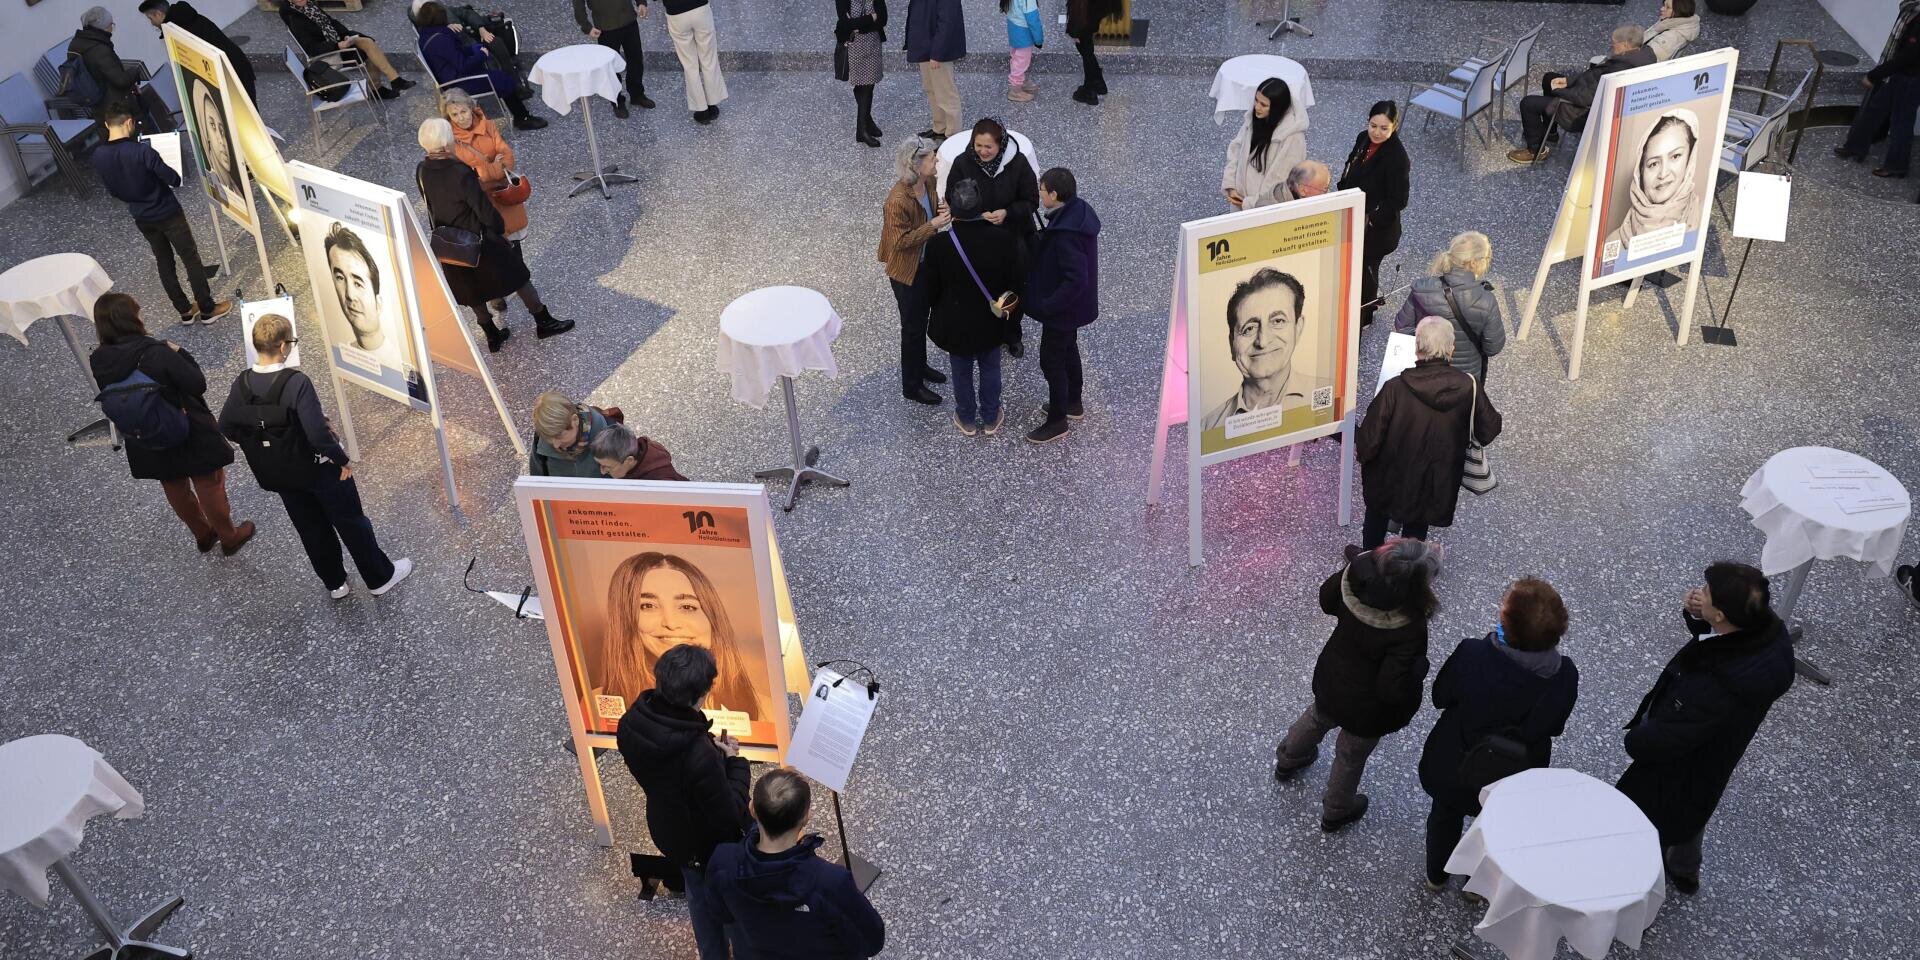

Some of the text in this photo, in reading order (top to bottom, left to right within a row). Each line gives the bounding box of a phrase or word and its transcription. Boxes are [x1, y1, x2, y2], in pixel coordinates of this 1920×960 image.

[1693, 72, 1709, 91] 10
[301, 184, 317, 201] 10
[1294, 220, 1330, 231] ankommen.
[1283, 229, 1329, 243] heimat finden.
[1206, 238, 1230, 262] 10
[1271, 238, 1329, 254] zukunft gestalten.
[567, 508, 617, 517] ankommen.
[569, 518, 632, 527] heimat finden.
[682, 510, 715, 534] 10
[606, 530, 650, 538] gestalten.
